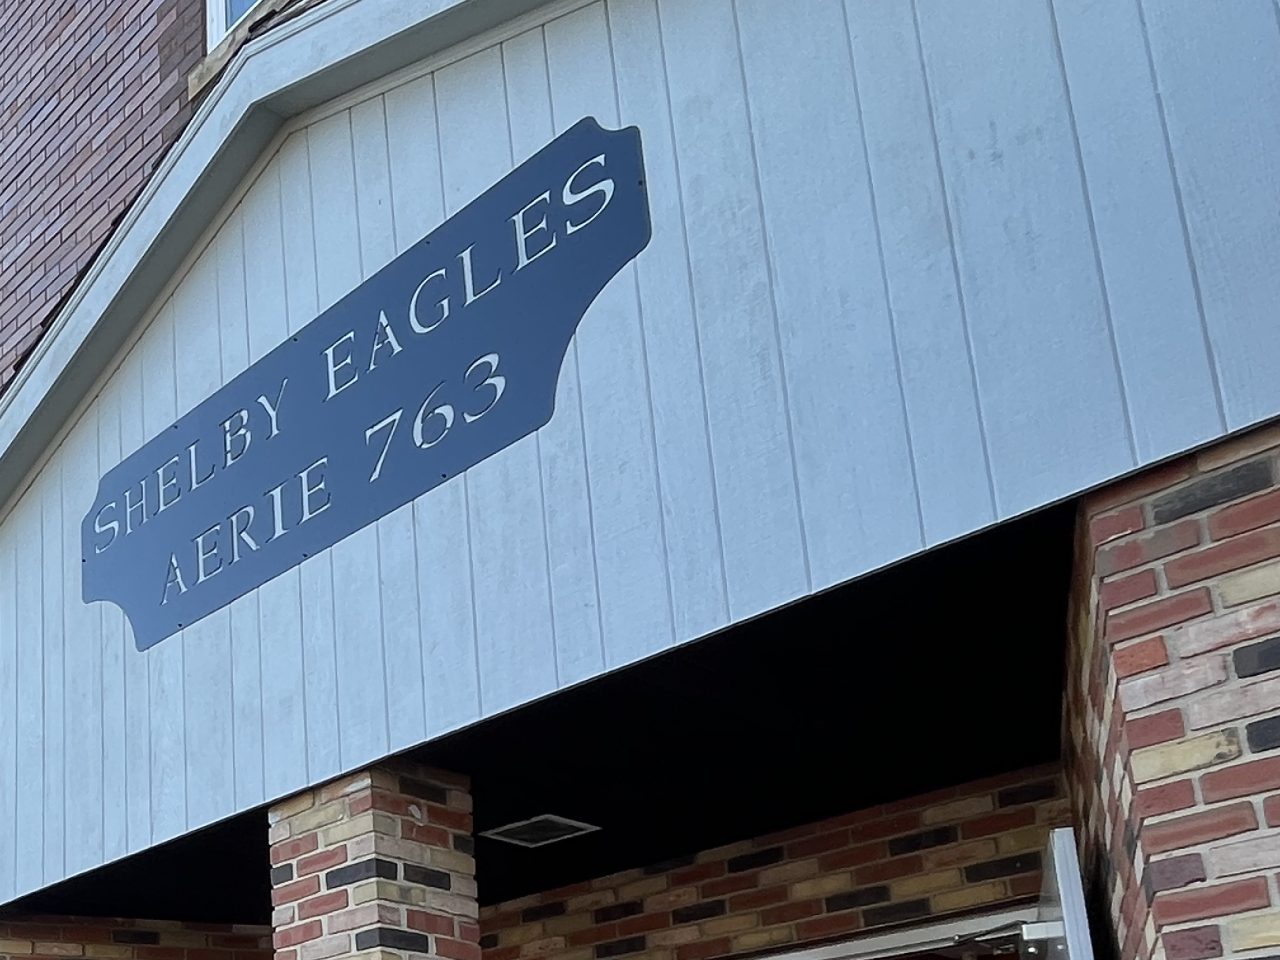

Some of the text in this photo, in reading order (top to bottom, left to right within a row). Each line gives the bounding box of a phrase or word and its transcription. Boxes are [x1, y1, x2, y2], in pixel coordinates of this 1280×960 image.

[94, 153, 616, 556] SHELBY EAGLES
[161, 352, 508, 607] AERIE 763
